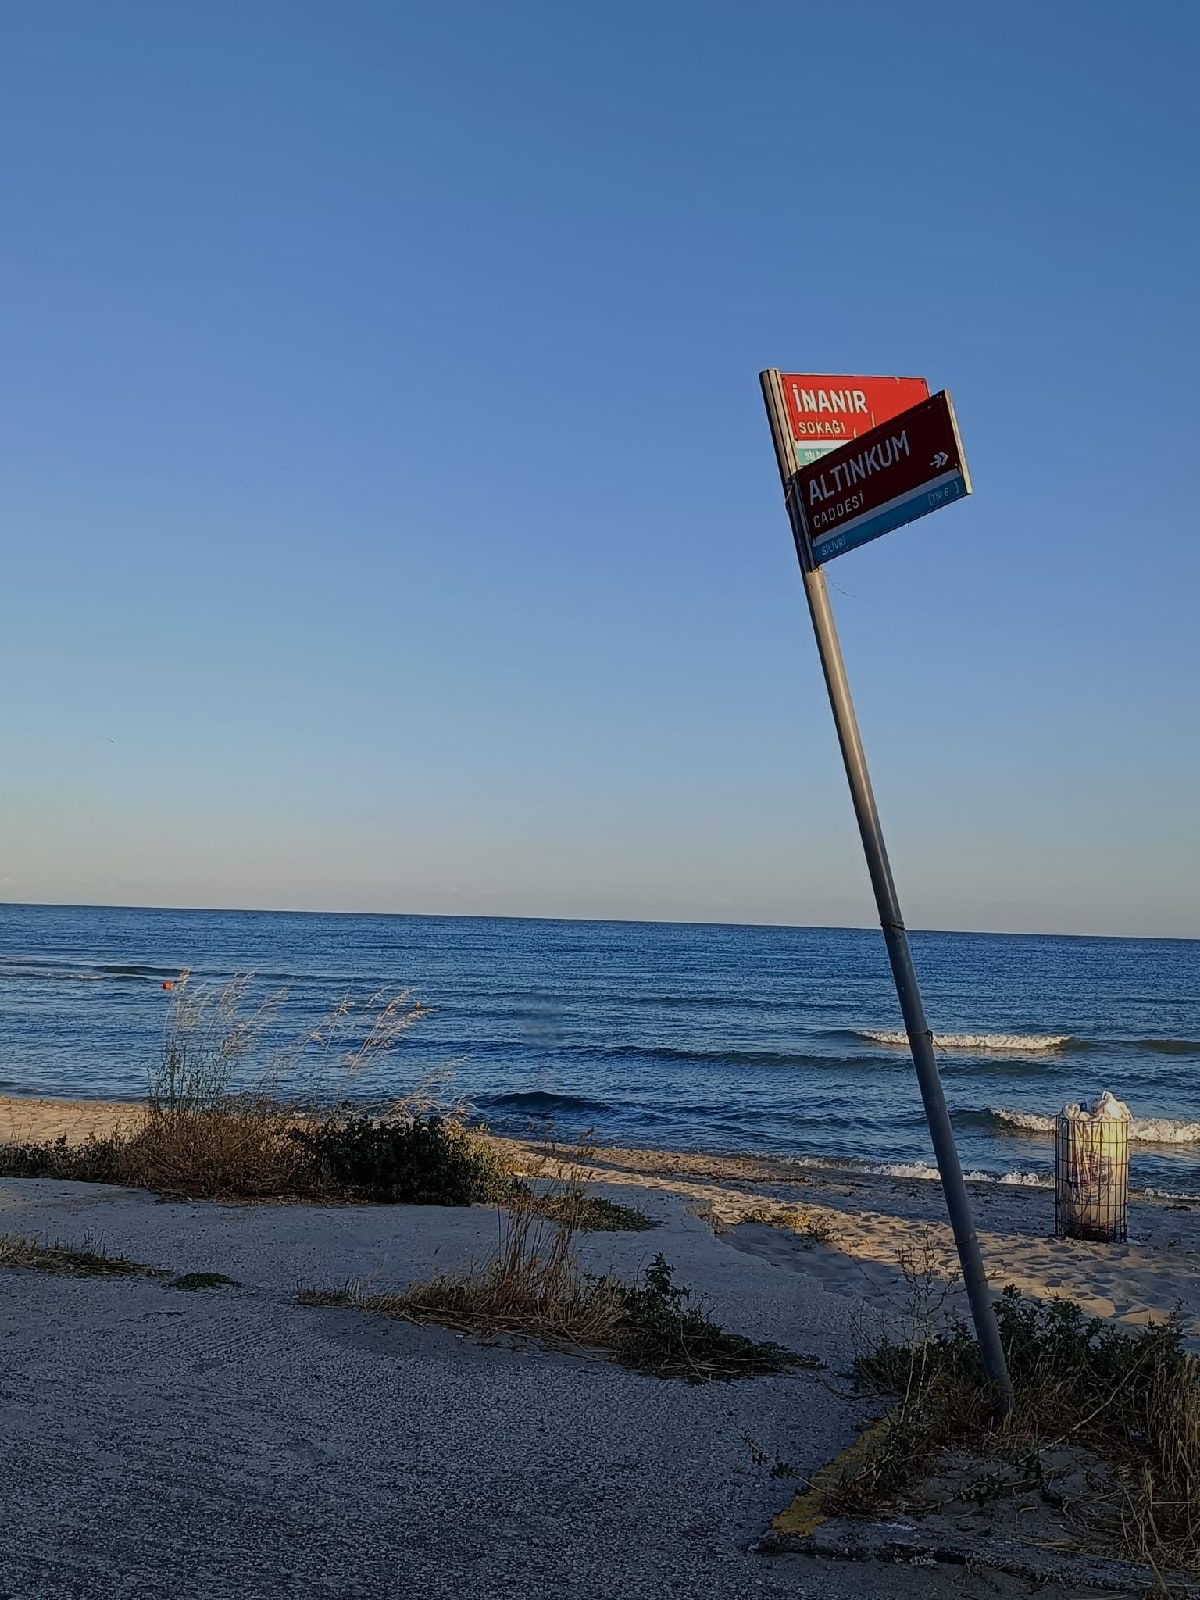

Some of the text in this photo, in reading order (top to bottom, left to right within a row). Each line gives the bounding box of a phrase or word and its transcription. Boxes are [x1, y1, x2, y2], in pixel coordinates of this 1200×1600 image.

[792, 383, 868, 414] İNANIR
[798, 421, 846, 435] SOKAĞI
[808, 430, 911, 506] ALTINKUM
[813, 490, 865, 528] CADDESİ
